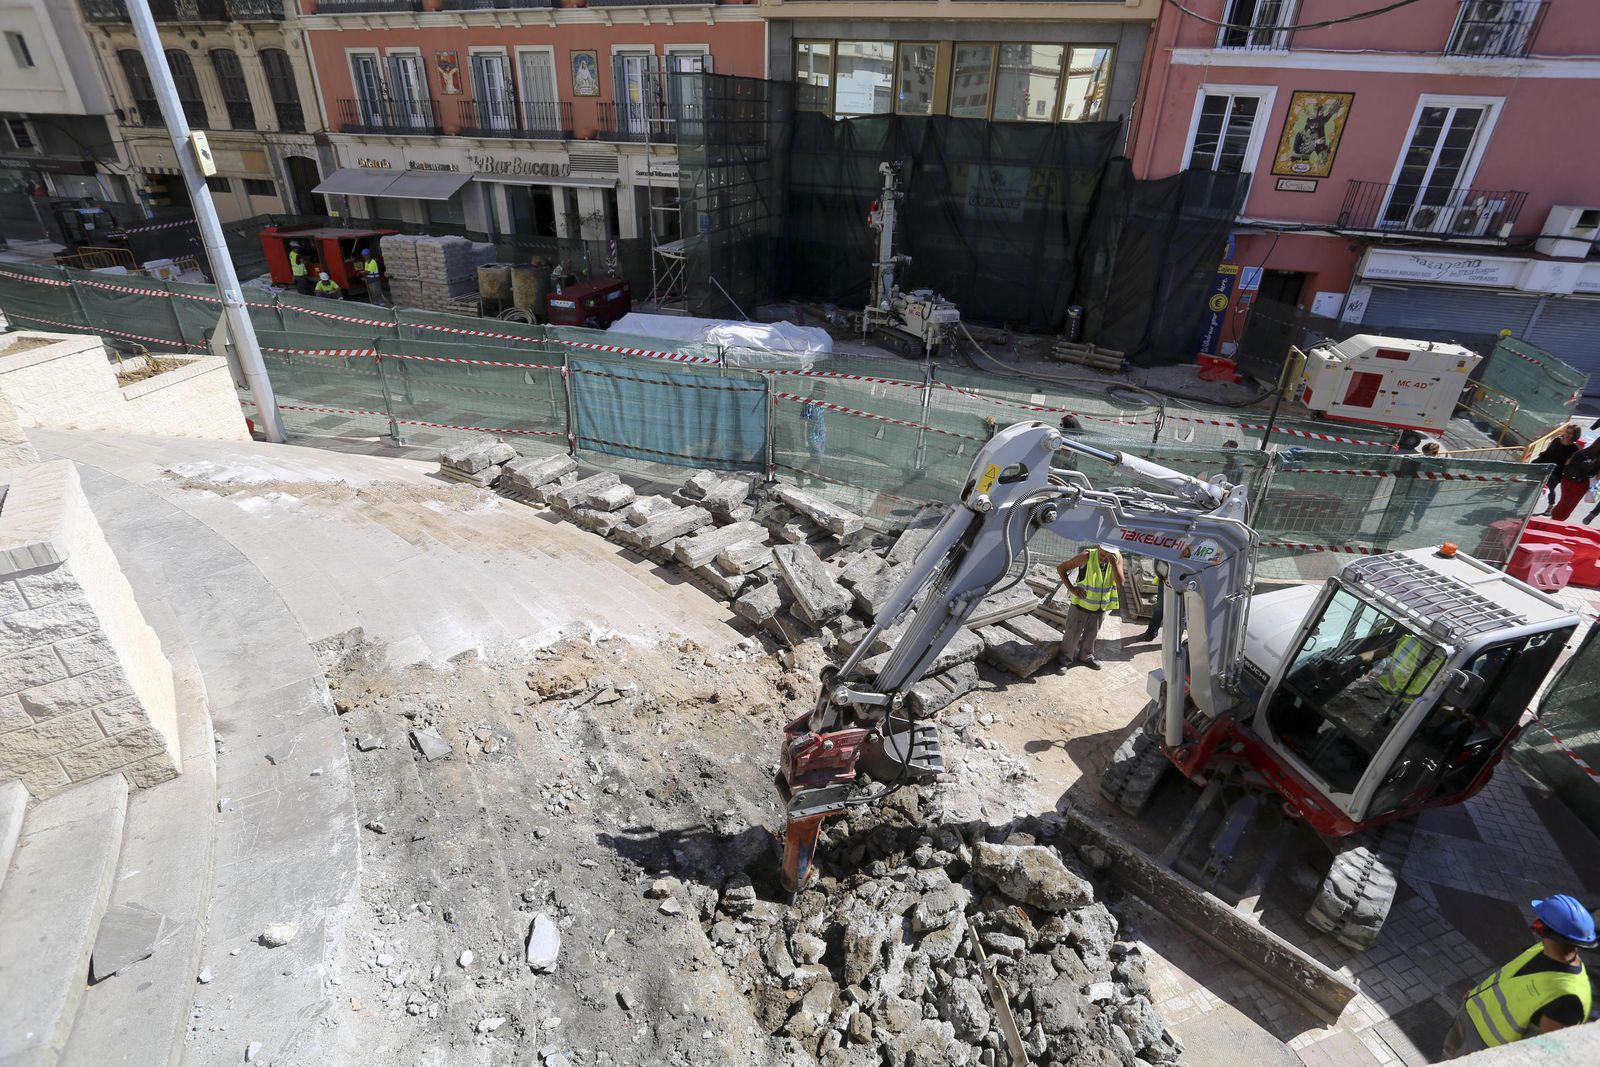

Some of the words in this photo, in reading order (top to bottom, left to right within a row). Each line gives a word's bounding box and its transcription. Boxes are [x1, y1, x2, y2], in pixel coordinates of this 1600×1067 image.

[1397, 379, 1412, 388] MC
[1120, 528, 1186, 551] TAKEUCHI
[1193, 545, 1214, 558] MP
